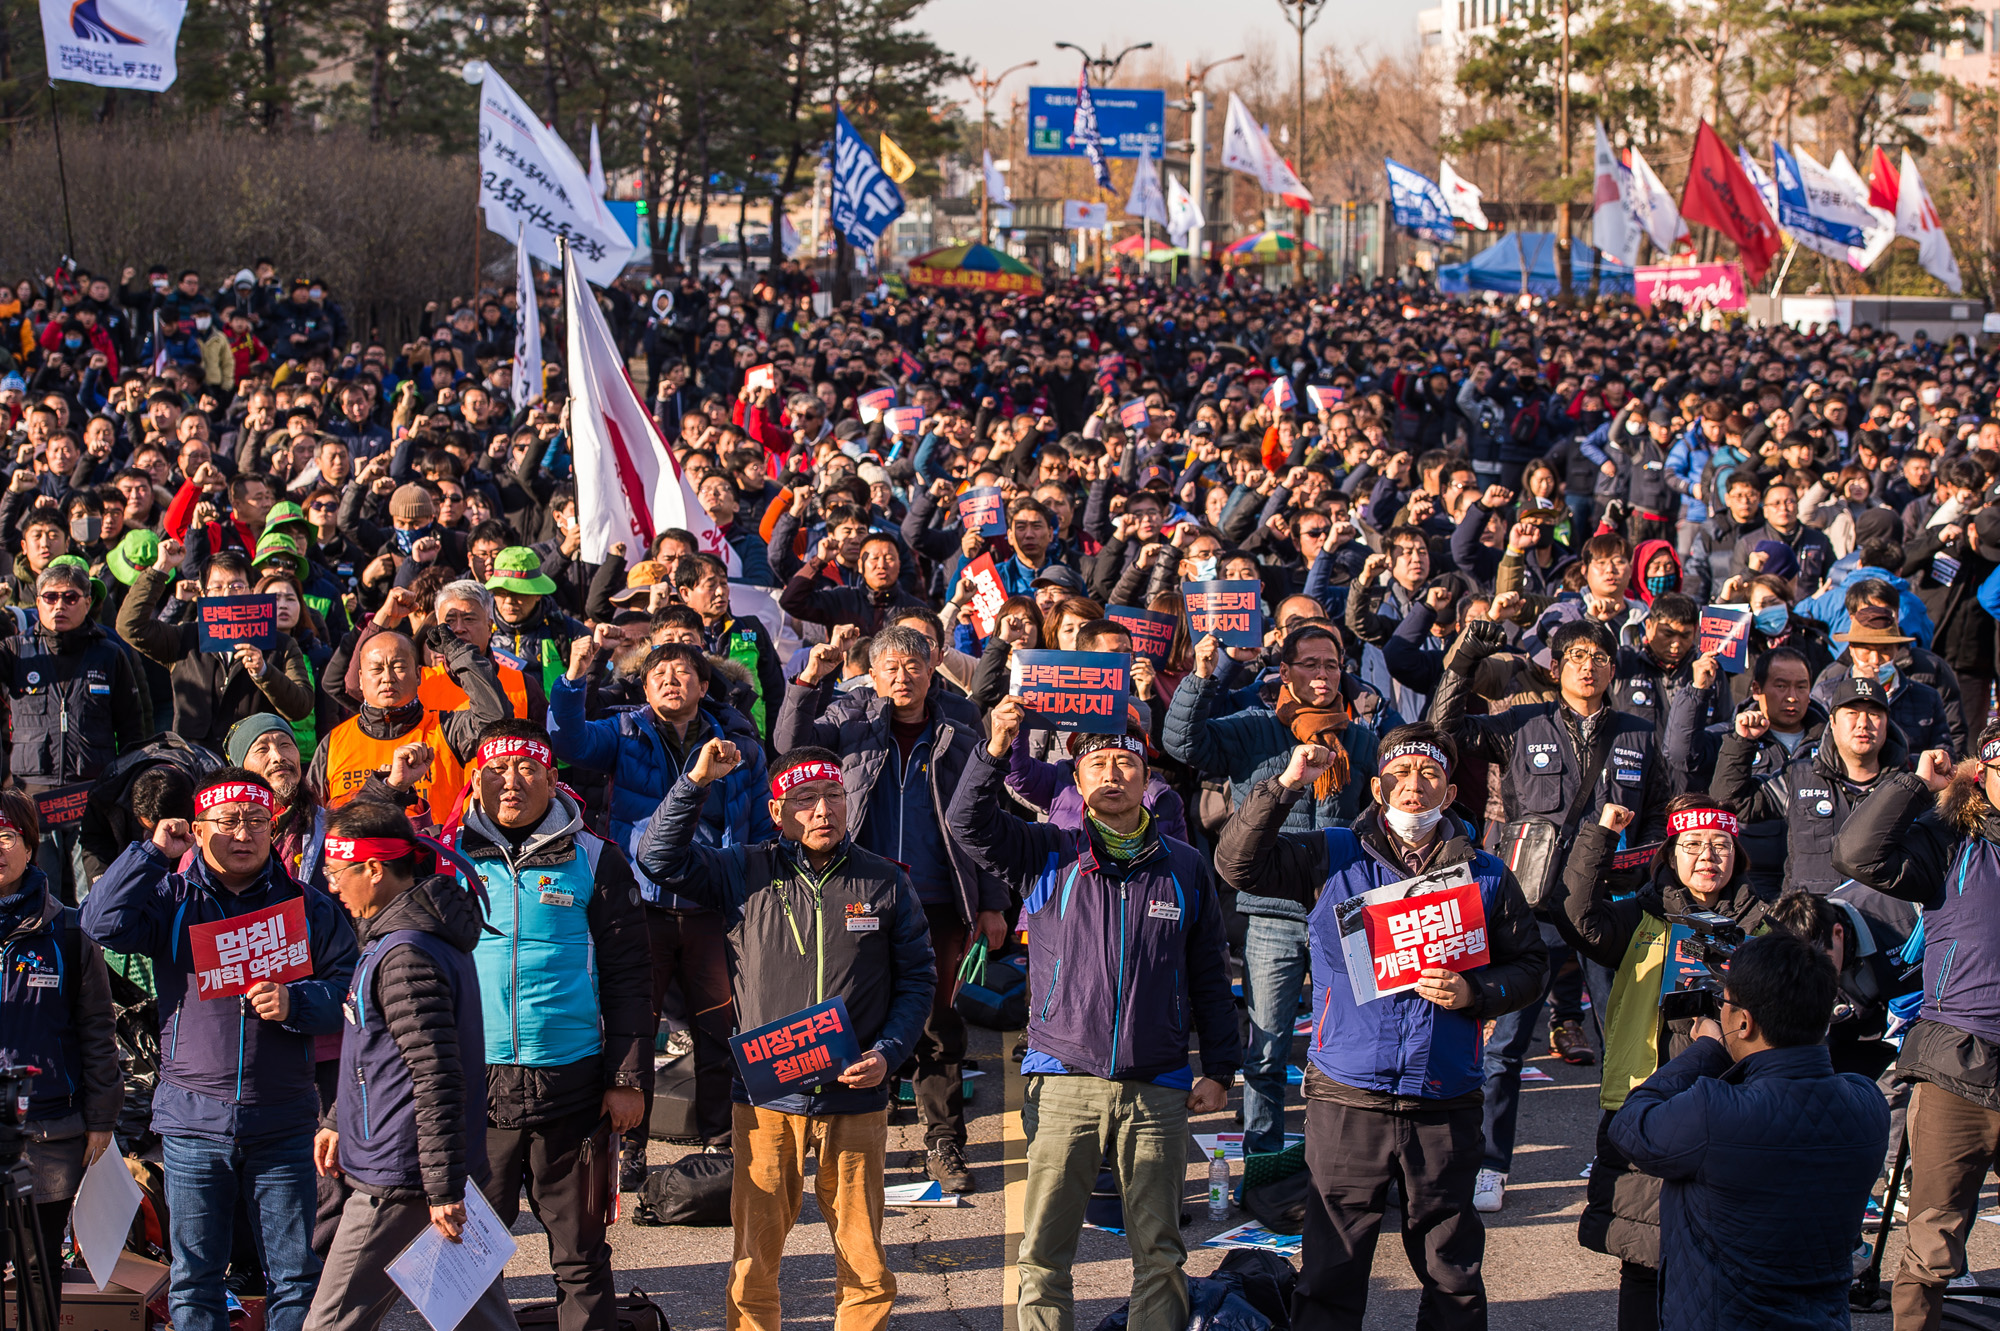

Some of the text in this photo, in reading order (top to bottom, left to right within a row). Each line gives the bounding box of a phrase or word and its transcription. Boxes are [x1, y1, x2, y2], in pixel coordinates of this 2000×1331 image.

[202, 602, 273, 623] 탄력근로제
[1186, 591, 1256, 612] 탄력근로제
[208, 621, 269, 640] 확대저지!
[1191, 613, 1250, 633] 확대저지!
[1020, 664, 1124, 691] 탄력근로제
[1856, 679, 1873, 696] LA
[1022, 690, 1114, 716] 확대저지!
[483, 738, 551, 764] 단결 투쟁
[778, 765, 805, 792] 단결
[39, 790, 89, 814] 탄력근로
[200, 784, 270, 809] 단결 투쟁
[1672, 810, 1738, 833] 단결 투쟁
[1387, 898, 1463, 950] 멈춰!
[215, 913, 287, 966] 멈춰!
[198, 939, 309, 992] 개혁 역주행
[1374, 927, 1487, 981] 개혁 역주행
[741, 1007, 844, 1064] 비정규직
[772, 1044, 833, 1084] 철폐!
